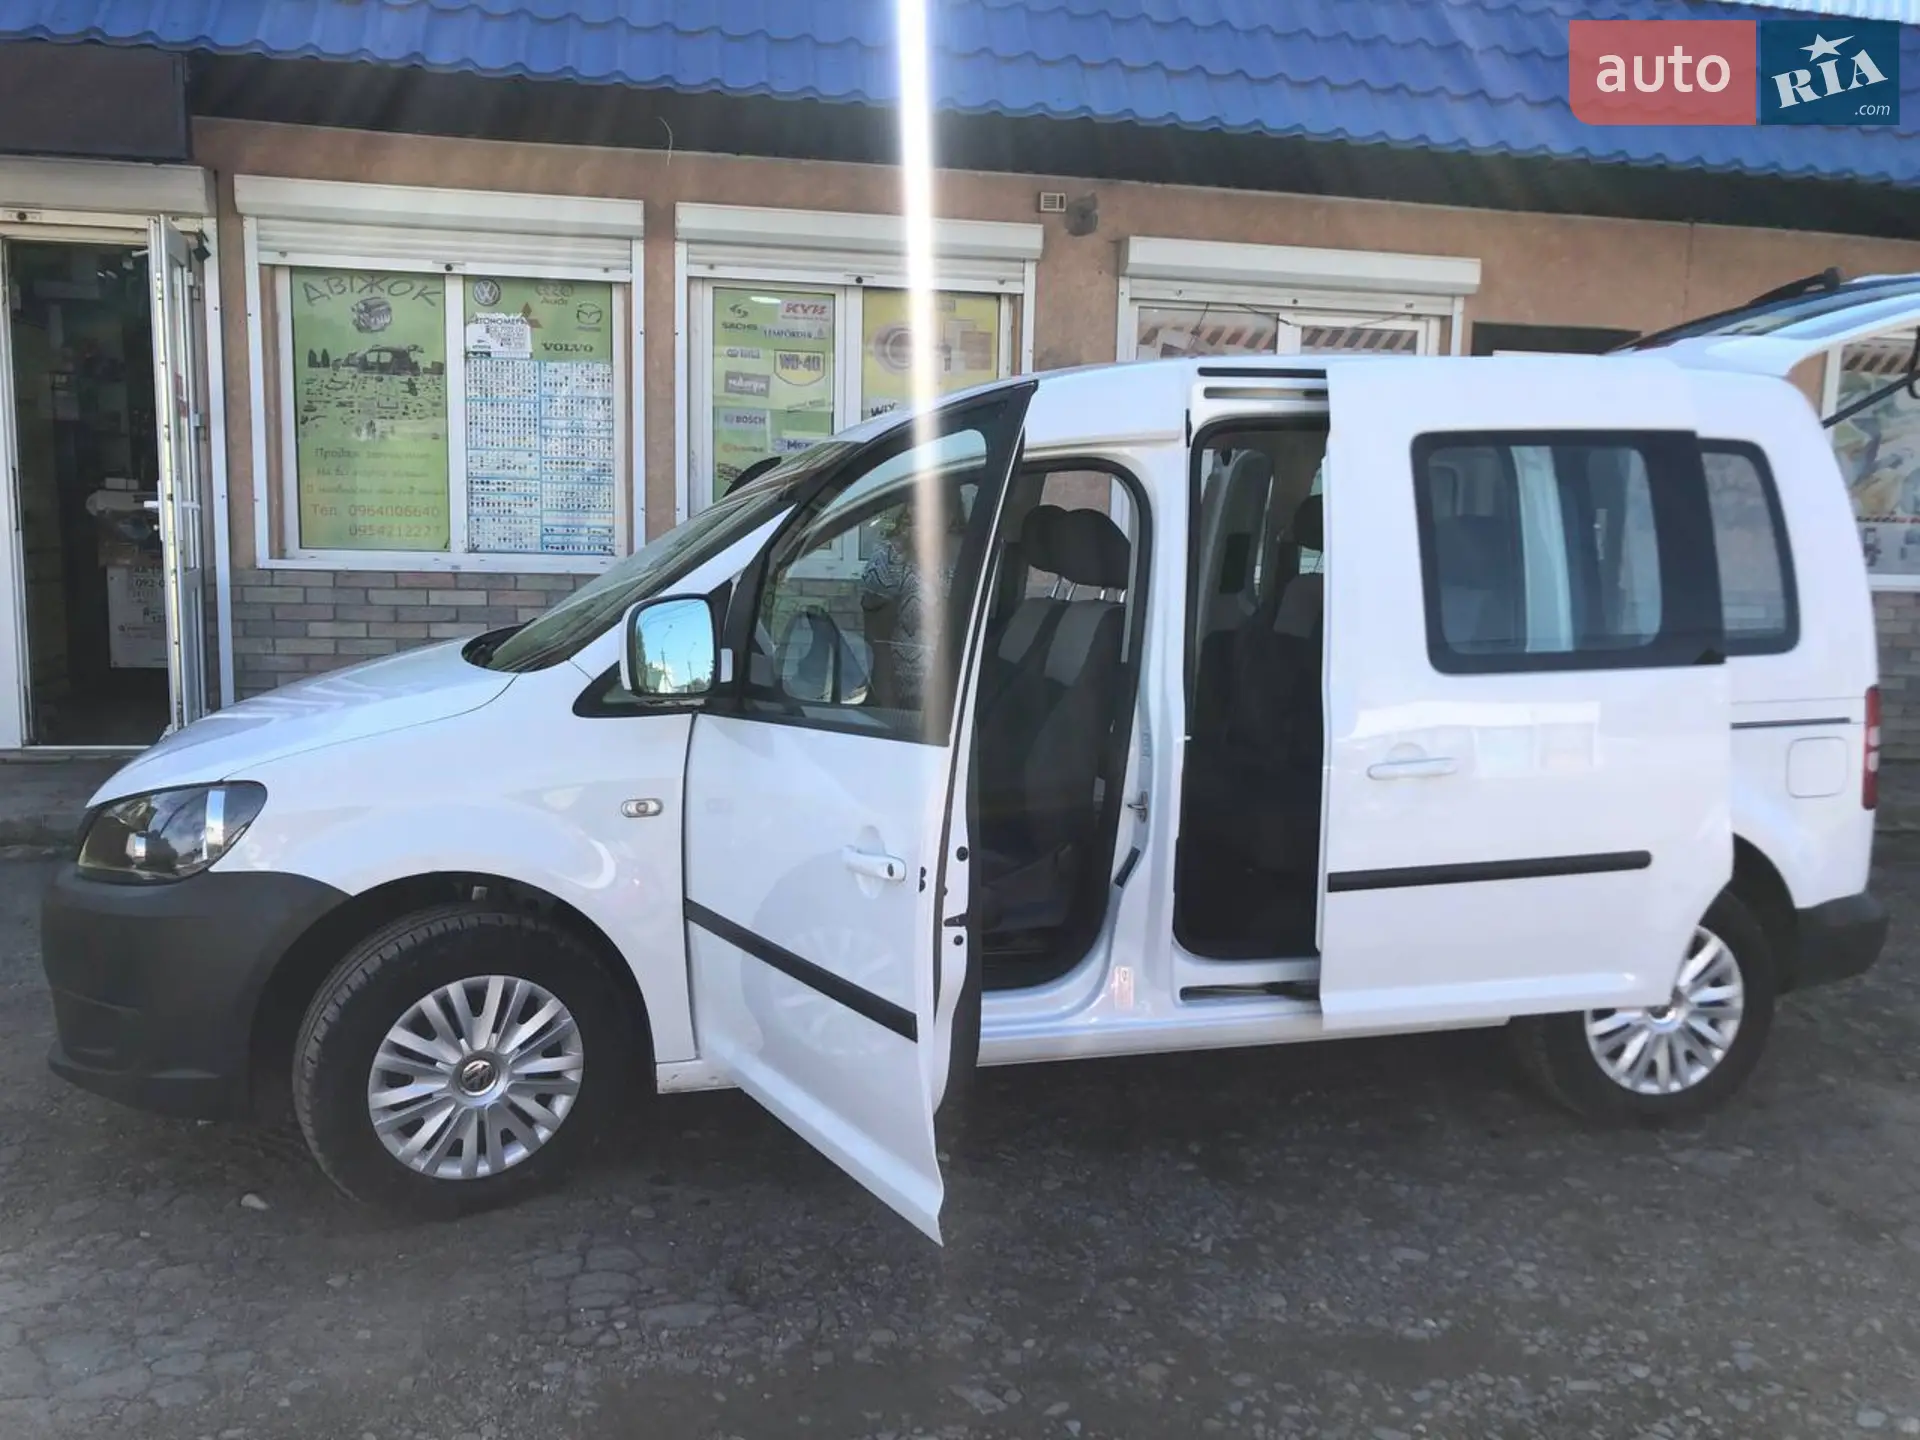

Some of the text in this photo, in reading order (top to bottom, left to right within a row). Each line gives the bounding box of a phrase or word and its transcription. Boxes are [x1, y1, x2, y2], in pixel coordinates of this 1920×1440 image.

[302, 275, 443, 307] ДВІЖОК
[721, 321, 759, 331] SACHS
[540, 342, 594, 353] VOLVO
[779, 352, 821, 372] WD-40
[735, 415, 766, 425] BOSCH
